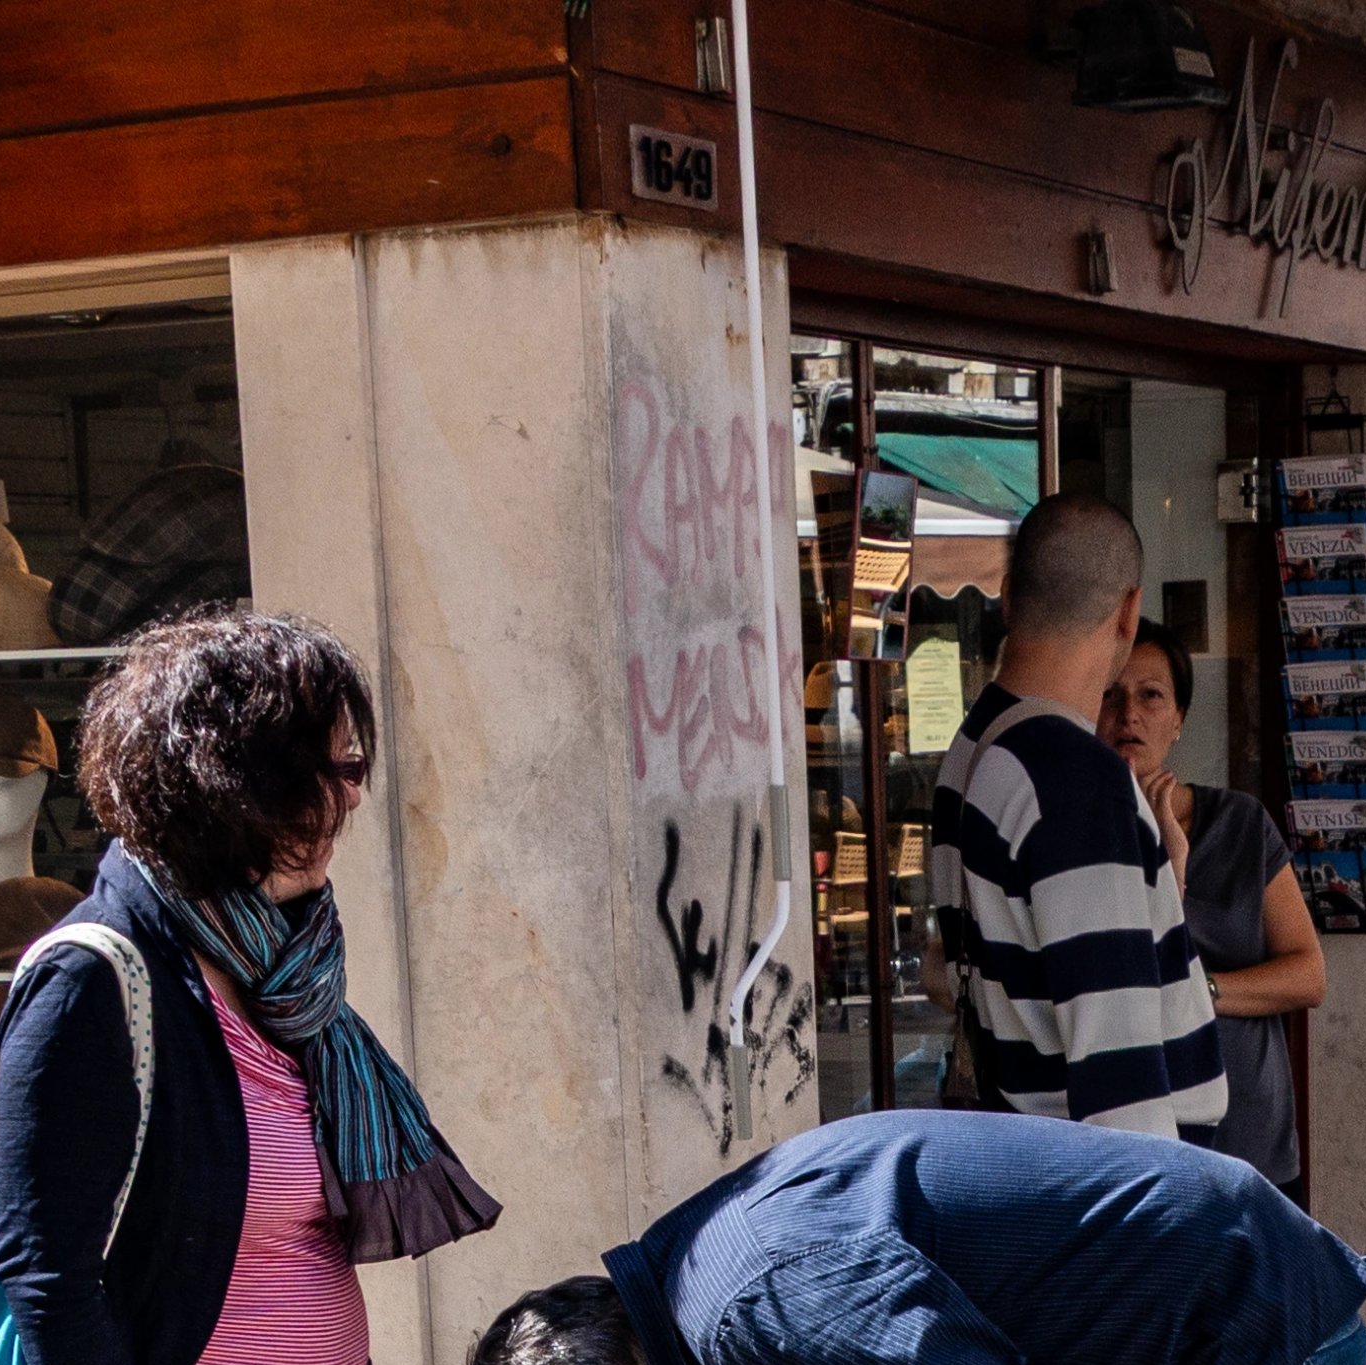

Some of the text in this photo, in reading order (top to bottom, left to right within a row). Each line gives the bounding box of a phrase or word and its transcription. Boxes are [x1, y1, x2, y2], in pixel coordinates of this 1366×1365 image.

[638, 136, 712, 201] 1649
[1288, 539, 1357, 555] VENEZIA
[1291, 609, 1361, 624] VENEDIG
[1292, 677, 1361, 692] ВЕНЕЦИИ
[1296, 744, 1364, 759] VENEDIG
[1300, 812, 1364, 827] VENISE
